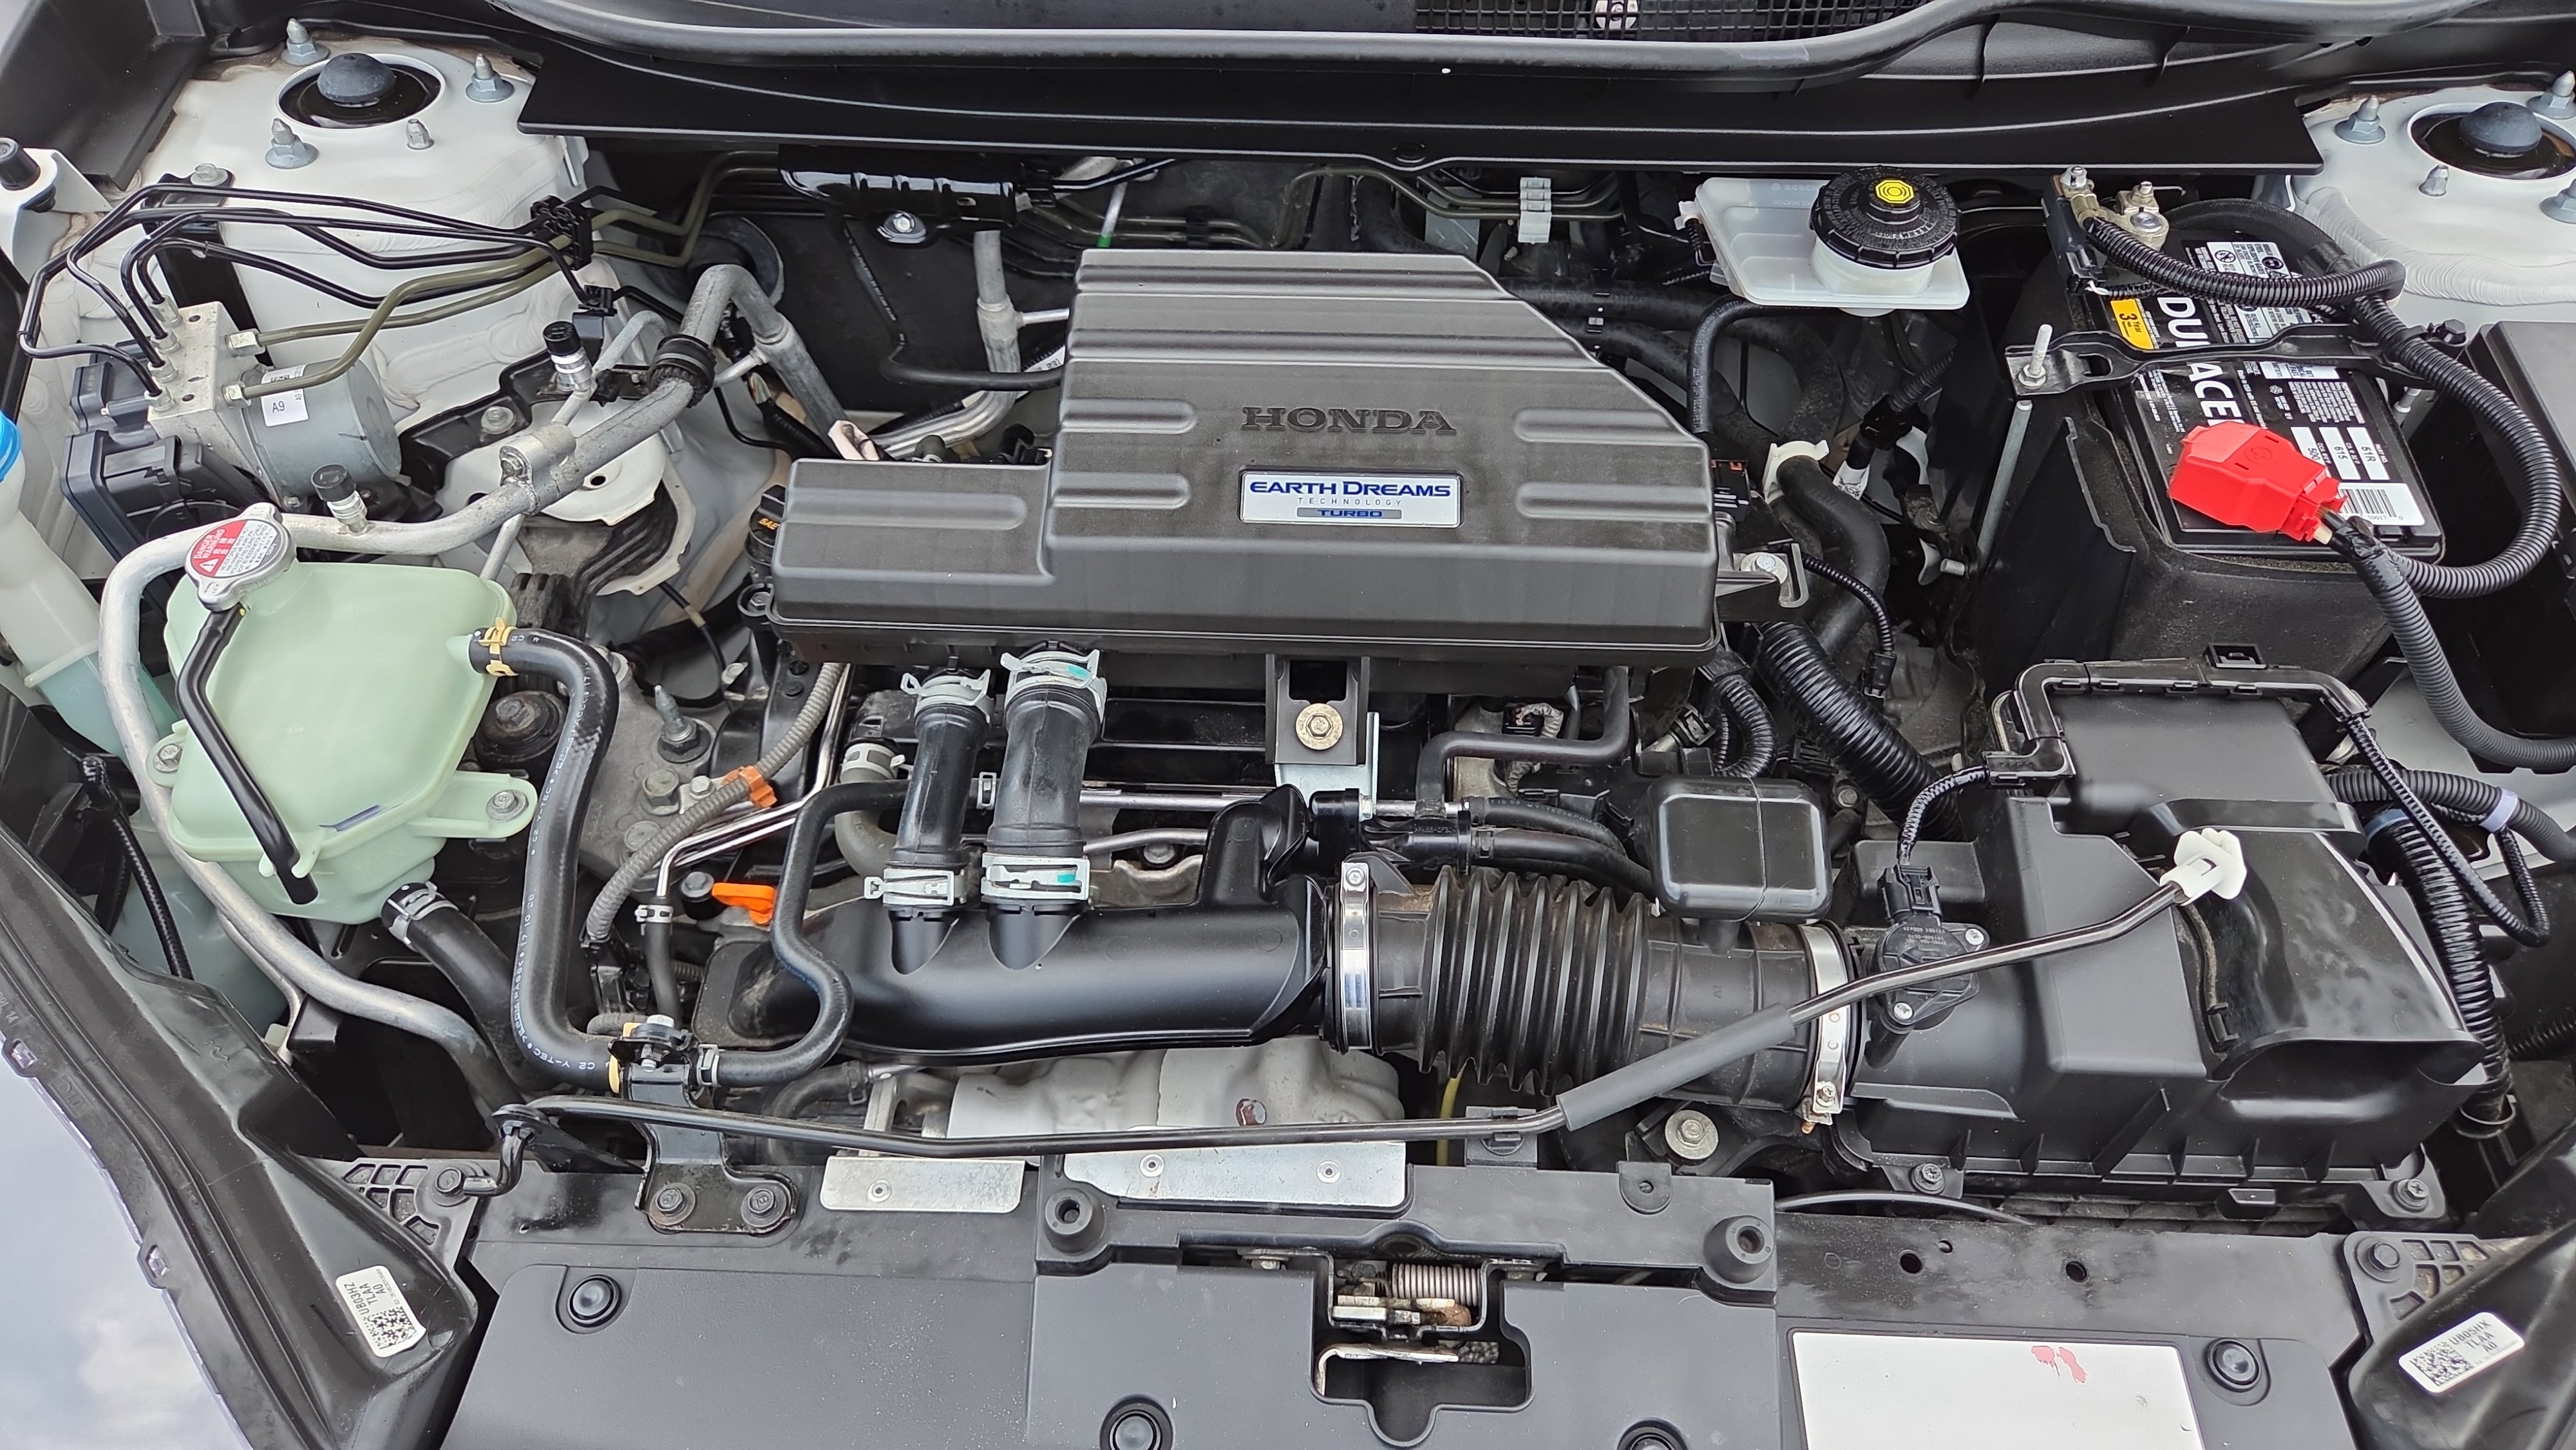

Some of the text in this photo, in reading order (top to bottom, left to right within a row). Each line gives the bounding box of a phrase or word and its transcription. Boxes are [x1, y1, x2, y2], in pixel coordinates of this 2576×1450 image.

[2131, 321, 2144, 332] Year
[270, 400, 285, 413] A9
[1242, 406, 1456, 435] HONDA
[2307, 447, 2321, 460] 500
[2333, 446, 2348, 459] 615
[2360, 446, 2376, 461] 51R
[1249, 480, 1452, 498] EARTH DREAMS
[1298, 497, 1402, 506] TECHNOLOGY
[1316, 509, 1383, 518] TURBO
[193, 533, 214, 559] DANGER
[536, 786, 553, 822] Y-TEC
[522, 913, 531, 927] 10
[533, 1048, 569, 1068] Y-TEC
[578, 1060, 595, 1071] C2
[344, 1281, 370, 1315] UB03HZ
[359, 1282, 377, 1304] TLAA
[2448, 1319, 2491, 1345] UB05HX
[2464, 1330, 2494, 1349] TLAA
